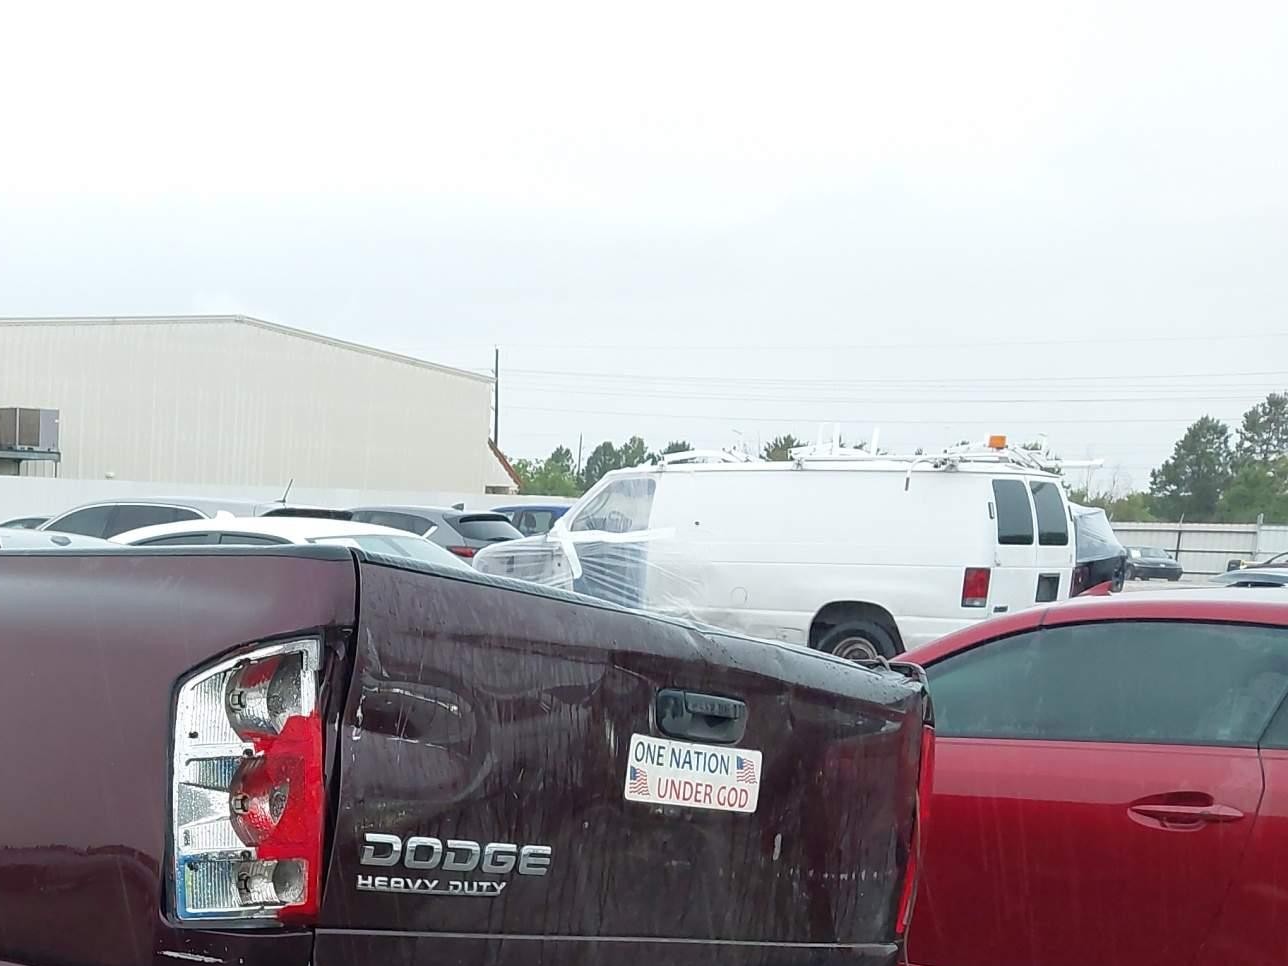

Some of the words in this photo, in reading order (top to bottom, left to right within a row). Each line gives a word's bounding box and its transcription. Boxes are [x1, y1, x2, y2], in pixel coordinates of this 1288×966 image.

[634, 741, 666, 766] ONE
[669, 747, 731, 776] NATION
[657, 777, 713, 805] UNDER
[716, 785, 749, 809] GOD
[359, 832, 552, 876] DODGE
[357, 874, 440, 893] HEAVY
[448, 880, 507, 896] DUTY
